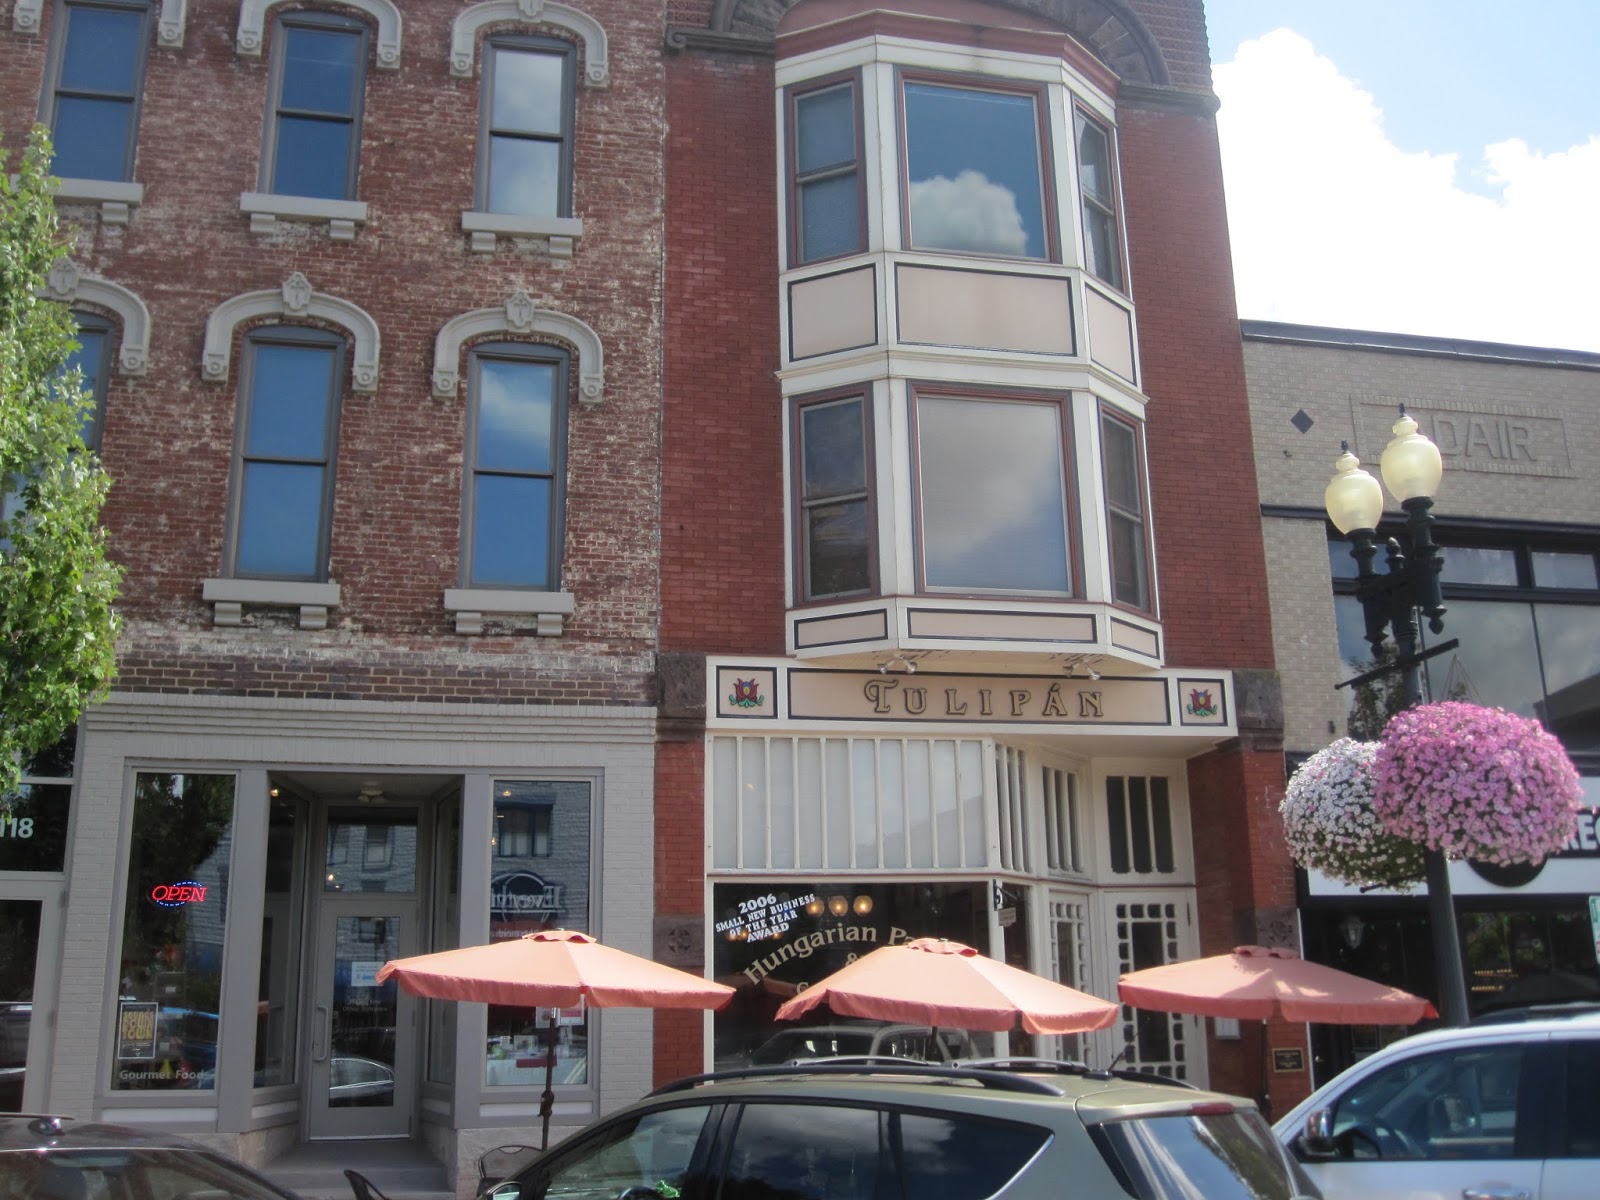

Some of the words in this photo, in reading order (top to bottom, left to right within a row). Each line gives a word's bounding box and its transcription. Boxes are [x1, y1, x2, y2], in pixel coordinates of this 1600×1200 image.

[864, 679, 1104, 717] TULIPÁN
[152, 885, 207, 902] OPEN
[738, 893, 777, 914] 2006
[715, 915, 745, 932] SMALL
[747, 906, 767, 923] NEW
[770, 893, 816, 915] BUSINESS
[729, 926, 743, 938] OF
[745, 919, 768, 934] THE
[773, 910, 798, 925] YEAR
[747, 922, 790, 942] AWARD
[743, 922, 877, 985] Hungarian
[120, 1069, 171, 1080] Gourmet
